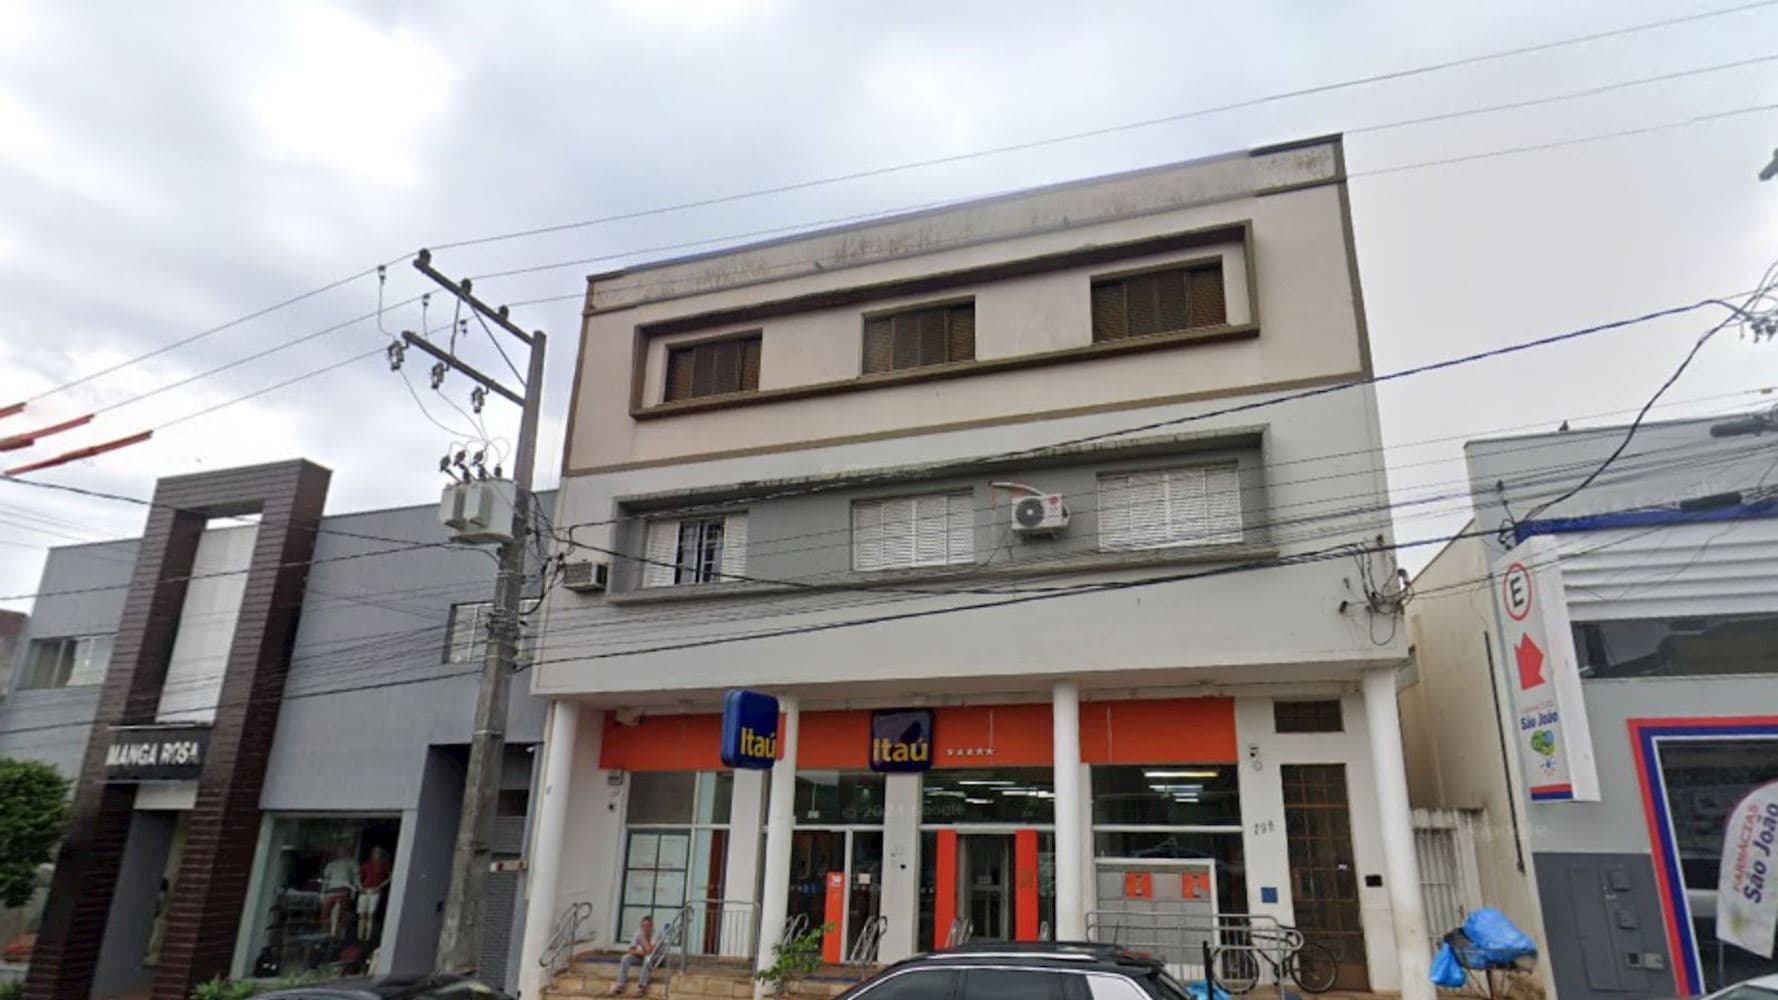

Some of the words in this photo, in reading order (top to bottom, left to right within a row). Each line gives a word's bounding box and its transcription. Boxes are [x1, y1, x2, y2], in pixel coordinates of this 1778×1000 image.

[1510, 576, 1525, 608] E
[105, 743, 158, 767] MANGA
[160, 741, 199, 766] ROSA
[740, 726, 776, 759] Itaú
[872, 737, 928, 763] Itaú
[1753, 803, 1778, 857] João
[1744, 860, 1767, 904] São
